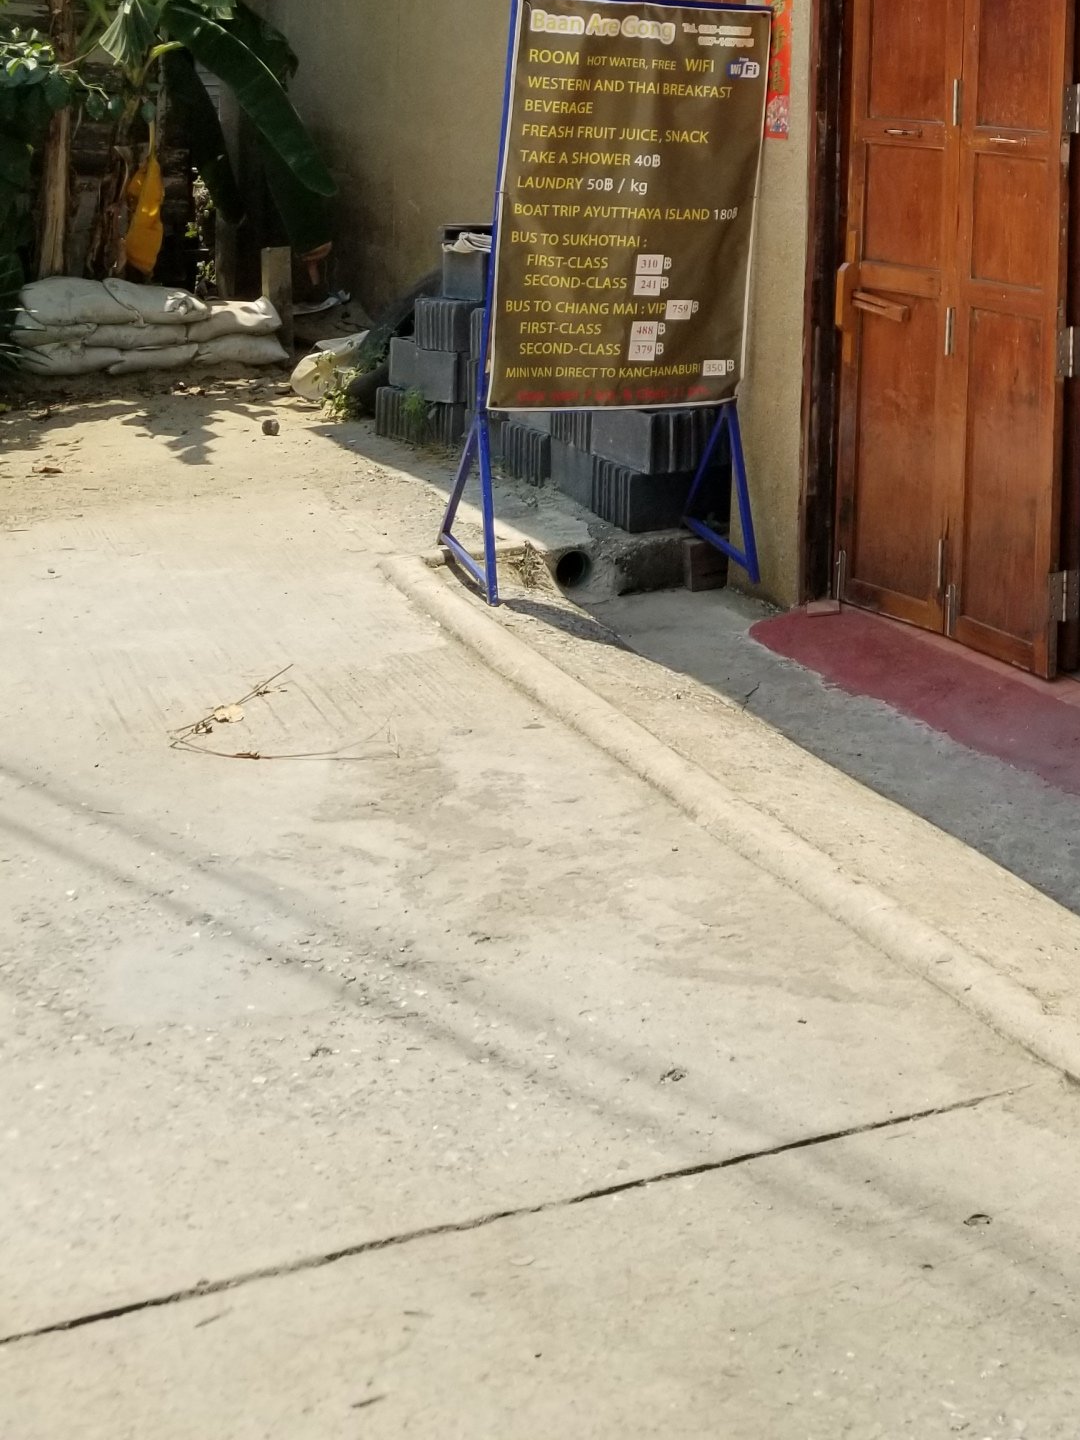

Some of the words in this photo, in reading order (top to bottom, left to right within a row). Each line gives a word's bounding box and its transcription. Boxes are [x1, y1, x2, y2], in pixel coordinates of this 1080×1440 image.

[531, 10, 584, 35] Baan
[586, 14, 620, 36] Are
[621, 16, 675, 44] Gong
[529, 49, 580, 65] ROOM
[587, 56, 607, 67] HOT
[609, 57, 648, 69] WATER,
[652, 59, 676, 71] FREE
[685, 58, 714, 73] WIFI
[528, 76, 590, 91] WESTERN
[594, 77, 625, 92] AND
[628, 80, 660, 95] THAI
[663, 83, 733, 99] BREAKFAST
[525, 100, 593, 114] BEVERAGE
[522, 124, 573, 138] FREASH
[577, 126, 616, 140] FRUIT
[619, 127, 662, 143] JUICE,
[665, 131, 709, 144] SNACK
[520, 150, 555, 164] TAKE
[559, 152, 568, 164] A
[572, 152, 631, 166] SHOWER
[517, 176, 583, 190] LAUNDRY
[630, 178, 648, 195] kg
[514, 203, 550, 215] BOAT
[552, 204, 580, 216] TRIP
[584, 205, 661, 220] AYUTTHAYA
[665, 208, 710, 220] ISLAND
[511, 231, 538, 244] BUS
[541, 232, 559, 245] TO
[562, 233, 640, 247] SUKHOTHAI
[527, 254, 609, 269] FIRST-CLASS
[523, 274, 627, 289] SECOND-CLASS
[505, 300, 532, 312] BUS
[534, 301, 552, 313] TO
[555, 302, 609, 315] CHIANG
[613, 302, 638, 315] MAI
[648, 303, 667, 315] VIP
[520, 322, 602, 335] FIRST-CLASS
[519, 343, 621, 356] SECOND-CLASS
[555, 367, 598, 378] DIRECT
[601, 367, 615, 378] TO
[619, 363, 700, 378] KANCHANABURI
[705, 363, 724, 373] 350
